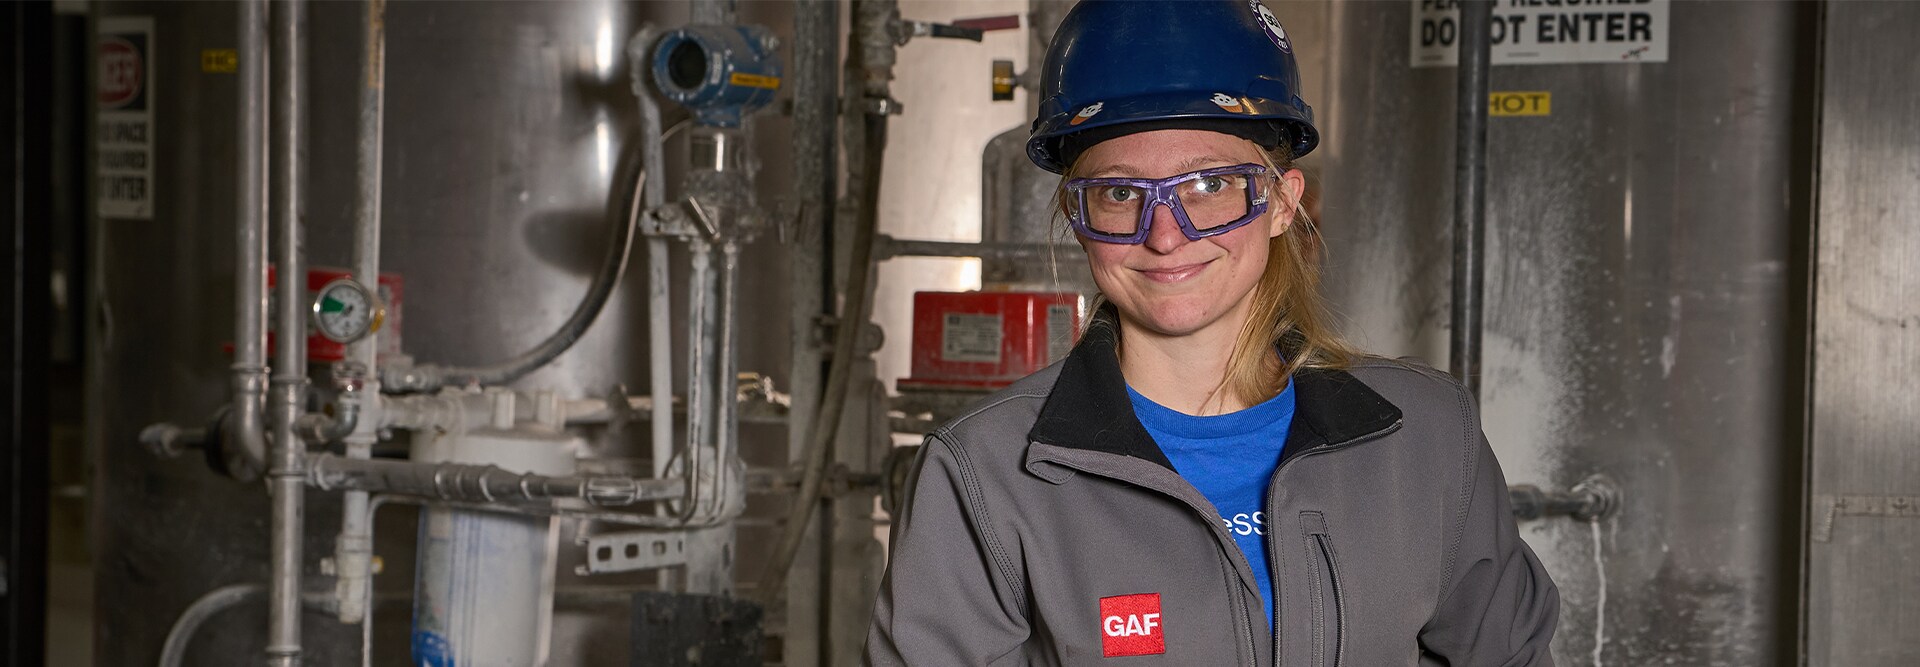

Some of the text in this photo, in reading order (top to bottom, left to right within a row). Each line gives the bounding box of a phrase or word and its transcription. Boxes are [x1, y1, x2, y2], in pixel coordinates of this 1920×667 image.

[1421, 12, 1652, 46] DO OT ENTER
[1103, 612, 1160, 637] GAF
